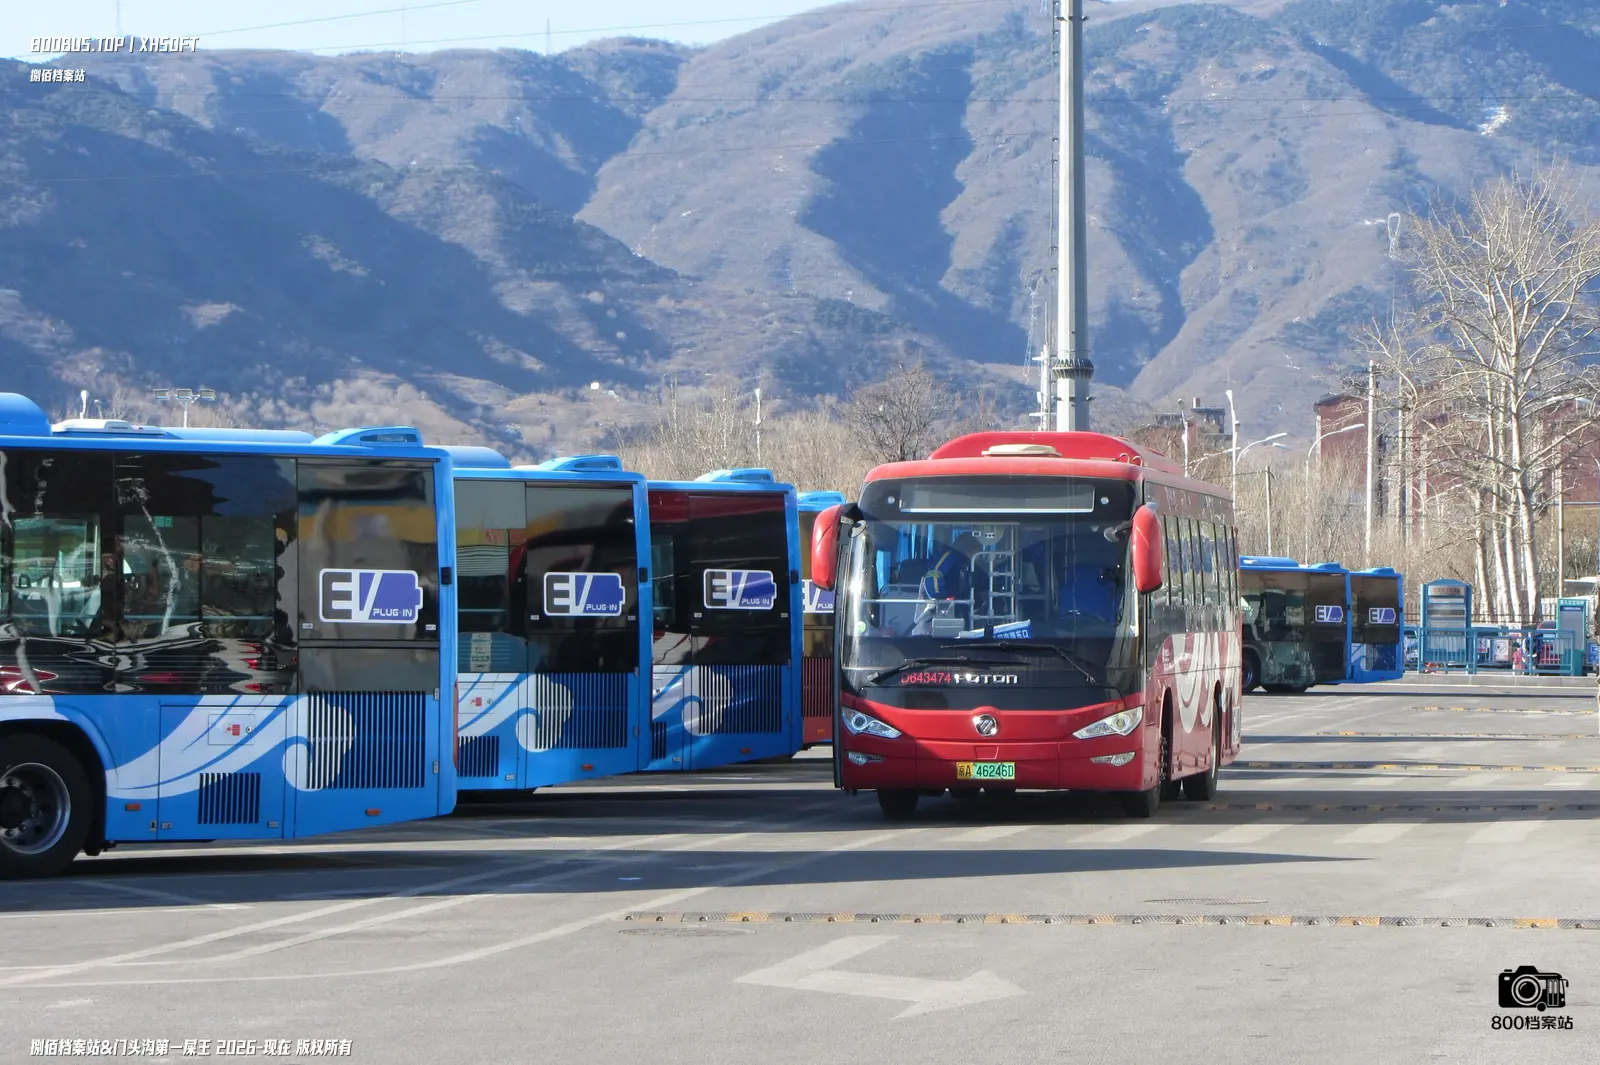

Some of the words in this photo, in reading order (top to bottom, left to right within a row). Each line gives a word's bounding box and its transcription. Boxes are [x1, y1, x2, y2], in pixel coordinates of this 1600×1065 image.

[322, 571, 383, 620] EV
[546, 574, 593, 614] EV
[703, 571, 748, 608] EV
[372, 608, 413, 617] PLUG-IN
